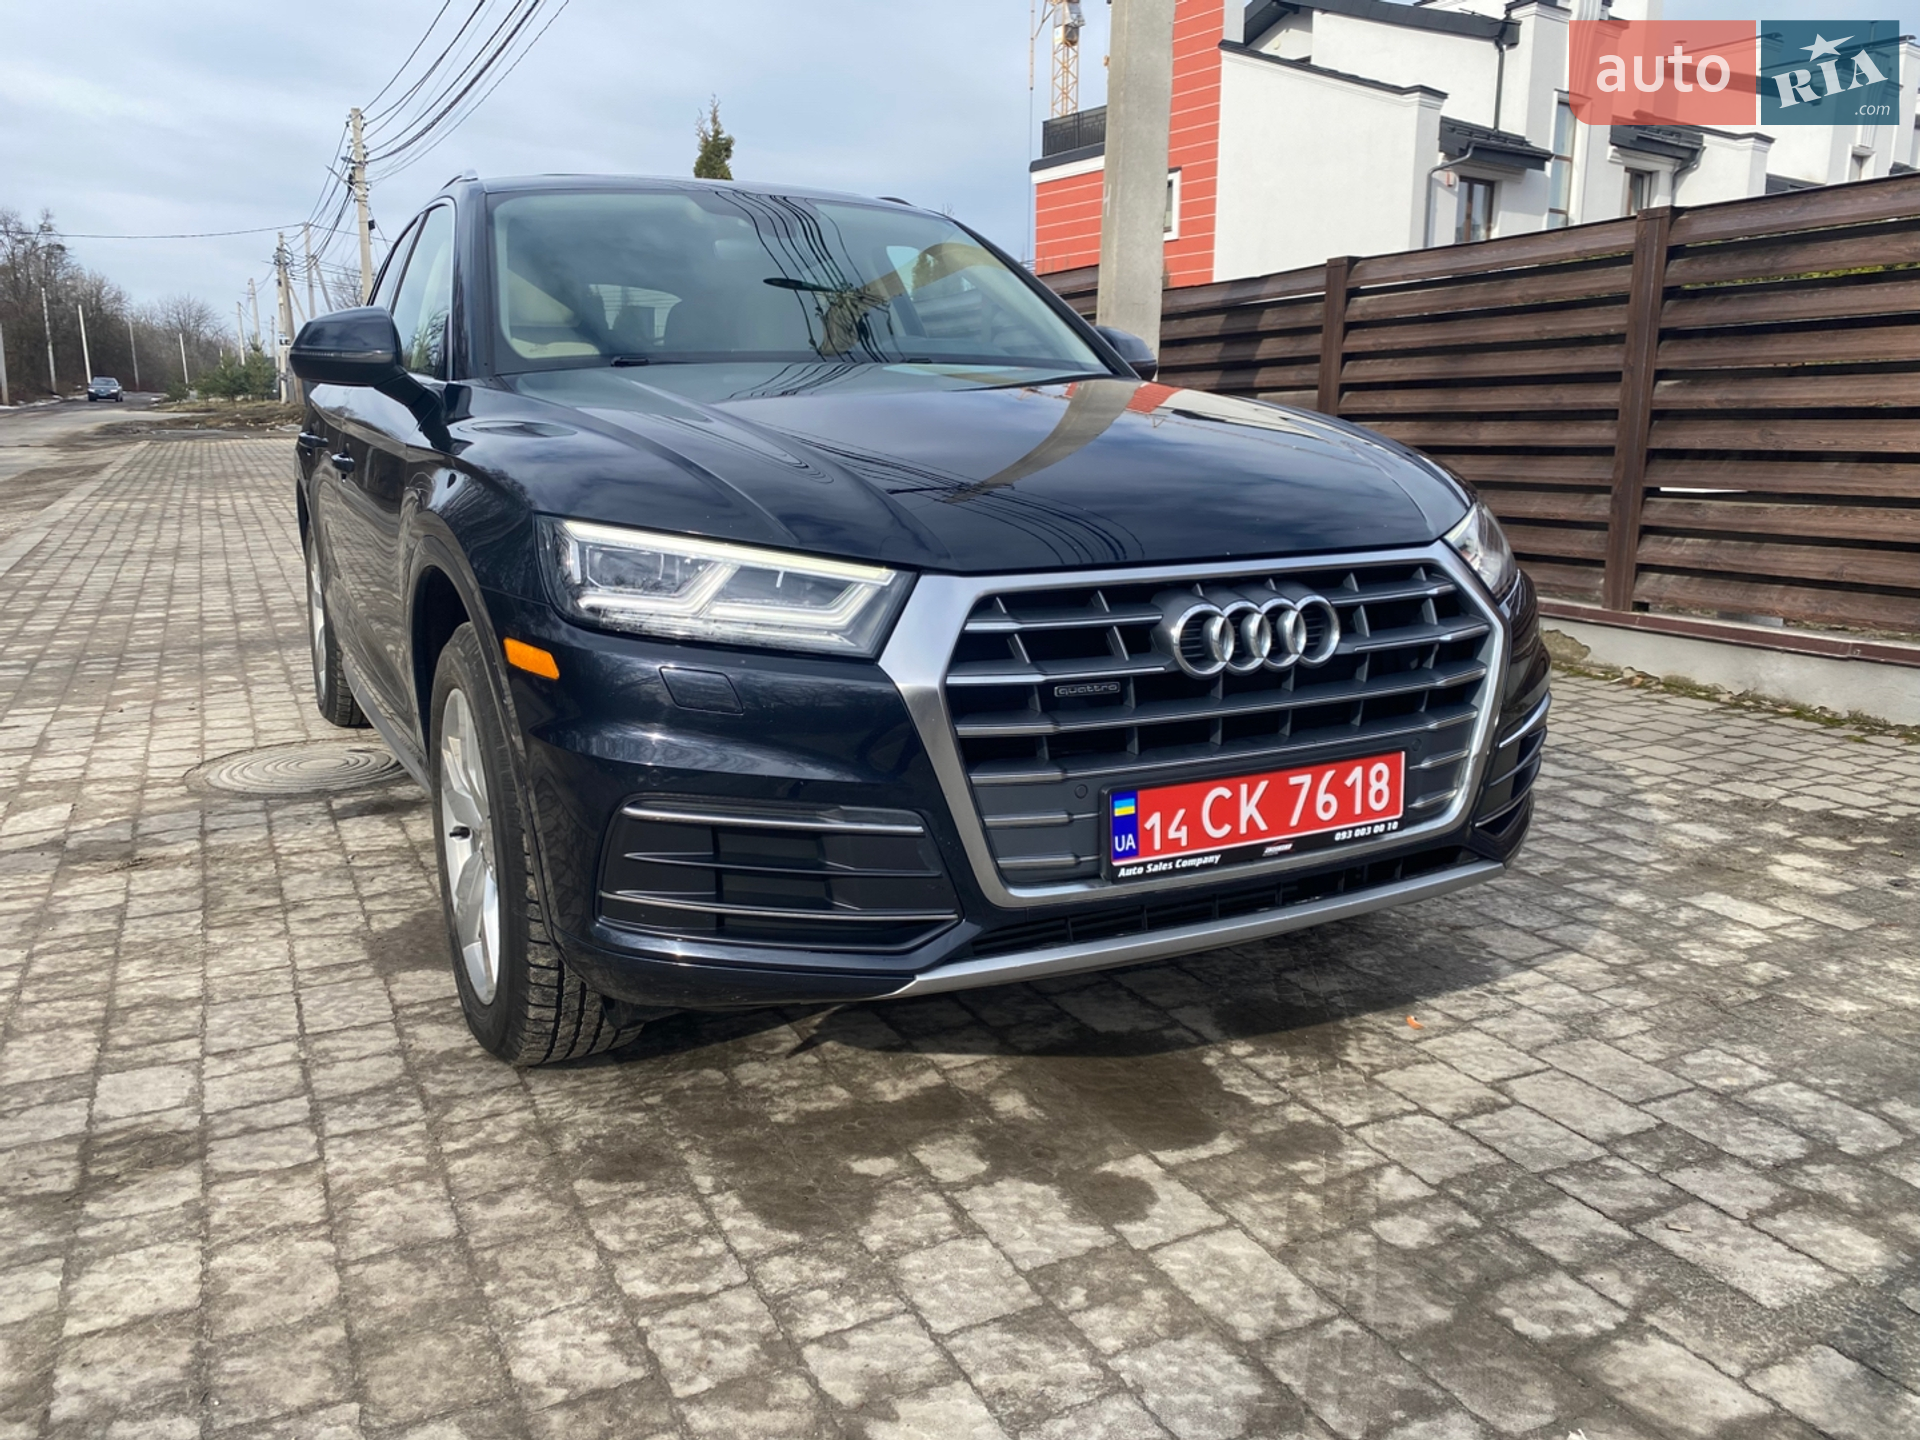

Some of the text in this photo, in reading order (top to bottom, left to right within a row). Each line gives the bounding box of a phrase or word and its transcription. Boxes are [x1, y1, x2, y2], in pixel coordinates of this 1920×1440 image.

[1059, 684, 1117, 696] quattro
[1114, 762, 1390, 852] UA 14 CK 7618
[1334, 831, 1352, 841] 093
[1118, 854, 1221, 878] Auto Sales Company
